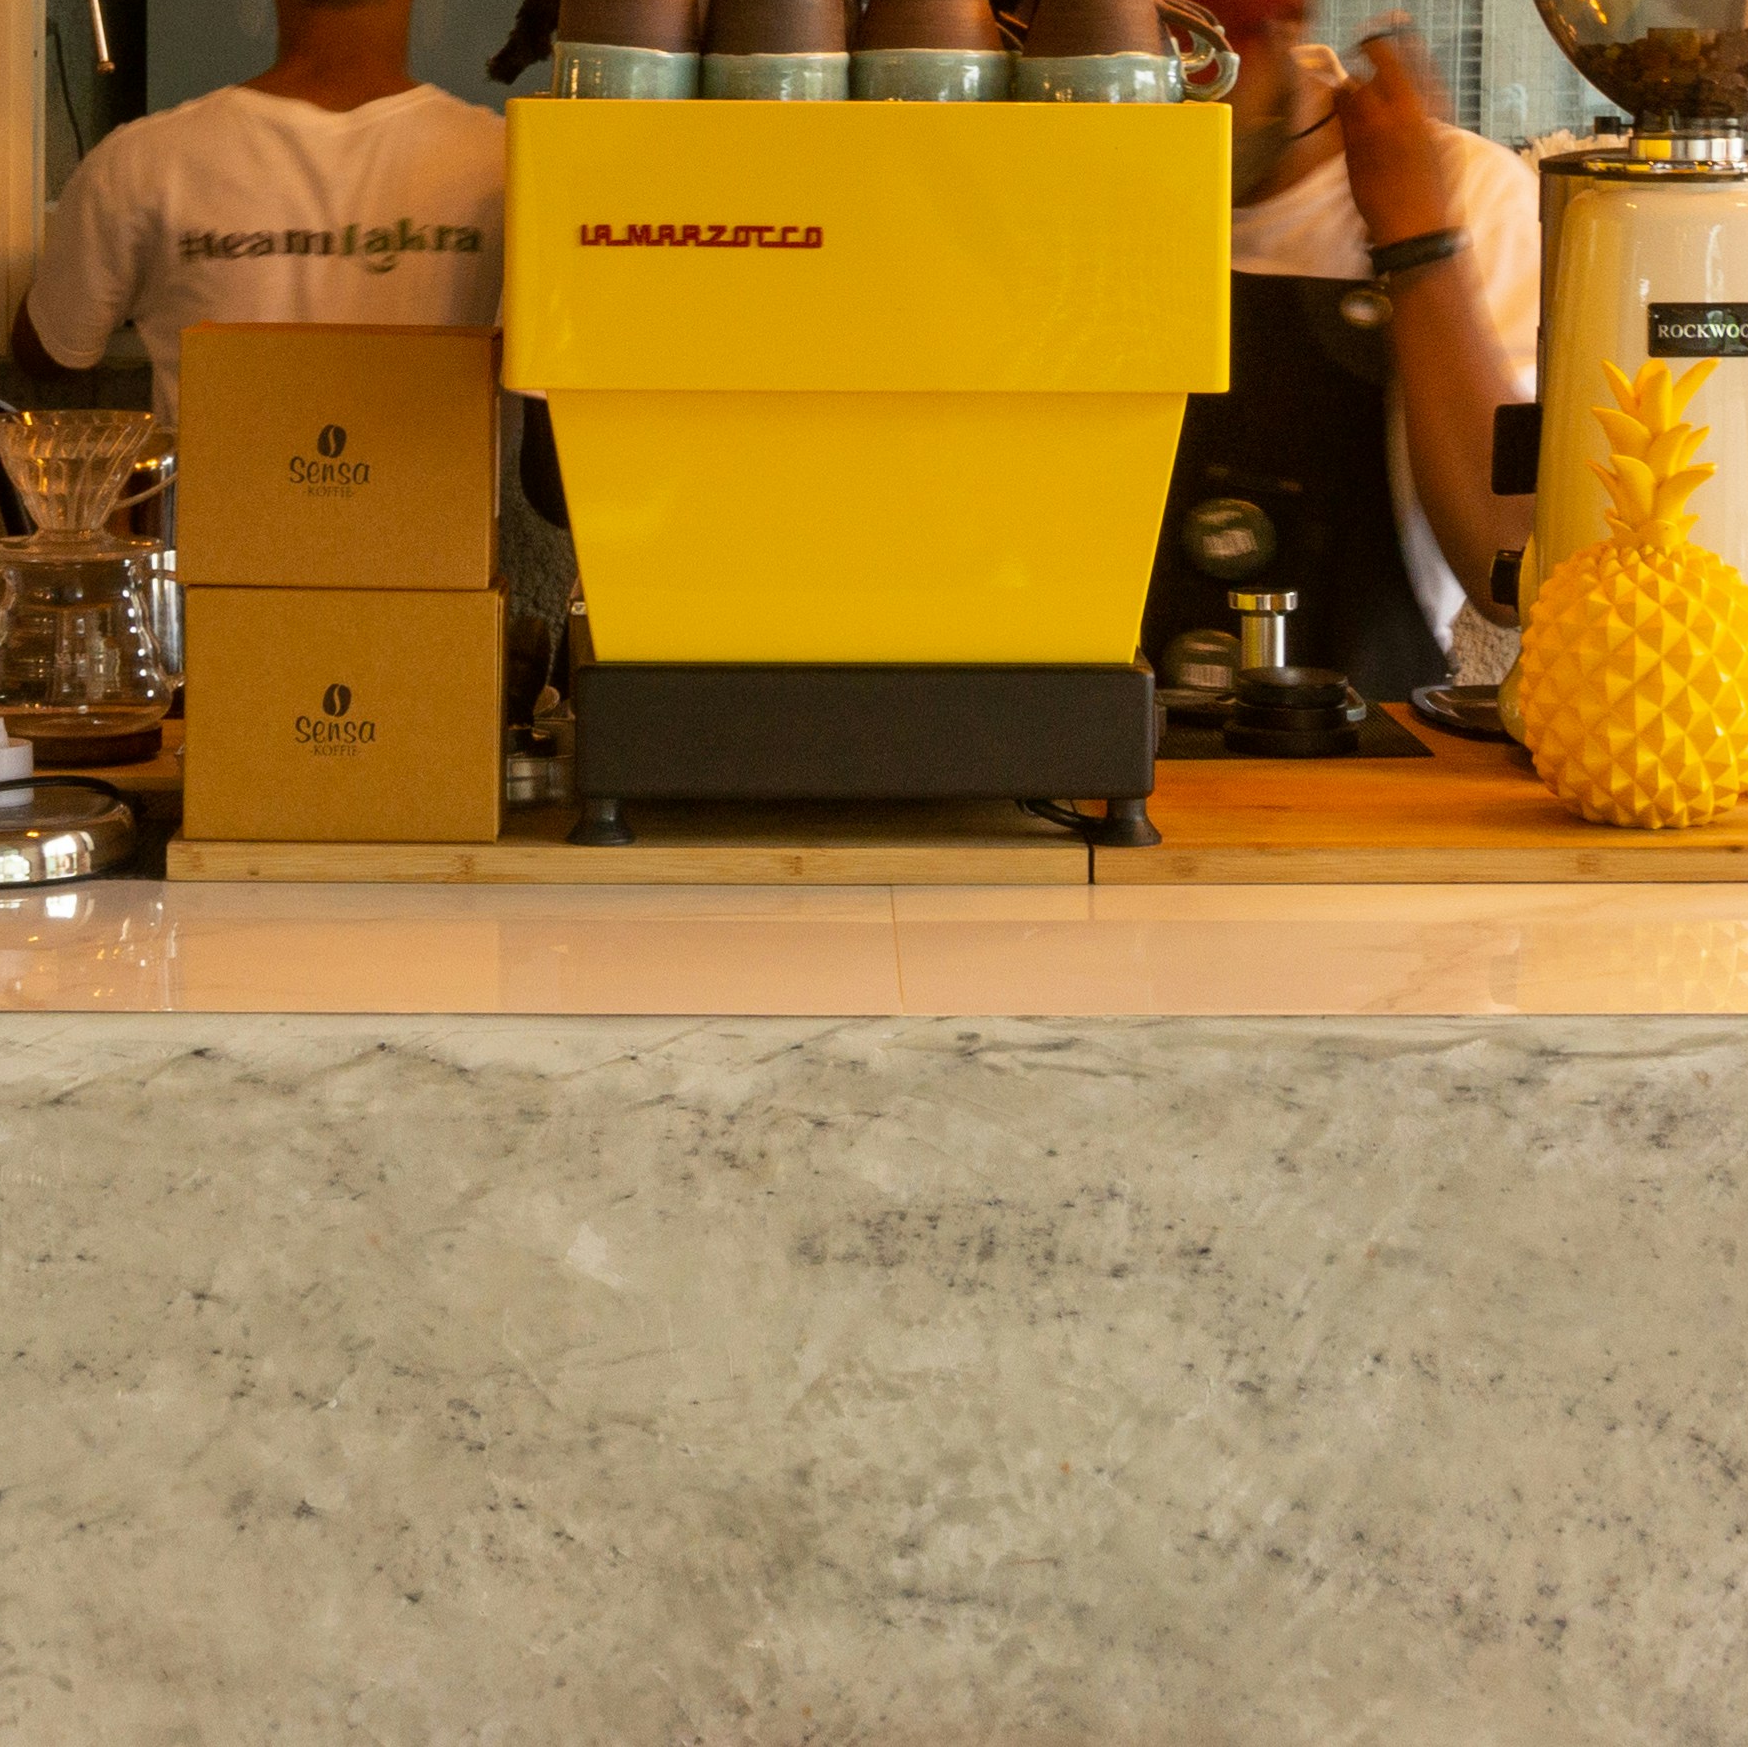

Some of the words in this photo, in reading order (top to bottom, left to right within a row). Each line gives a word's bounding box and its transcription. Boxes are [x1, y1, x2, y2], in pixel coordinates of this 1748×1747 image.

[580, 223, 612, 247] LA
[626, 223, 824, 249] MARZOCCO
[289, 455, 370, 485] Sensa
[295, 715, 376, 744] Sensa
